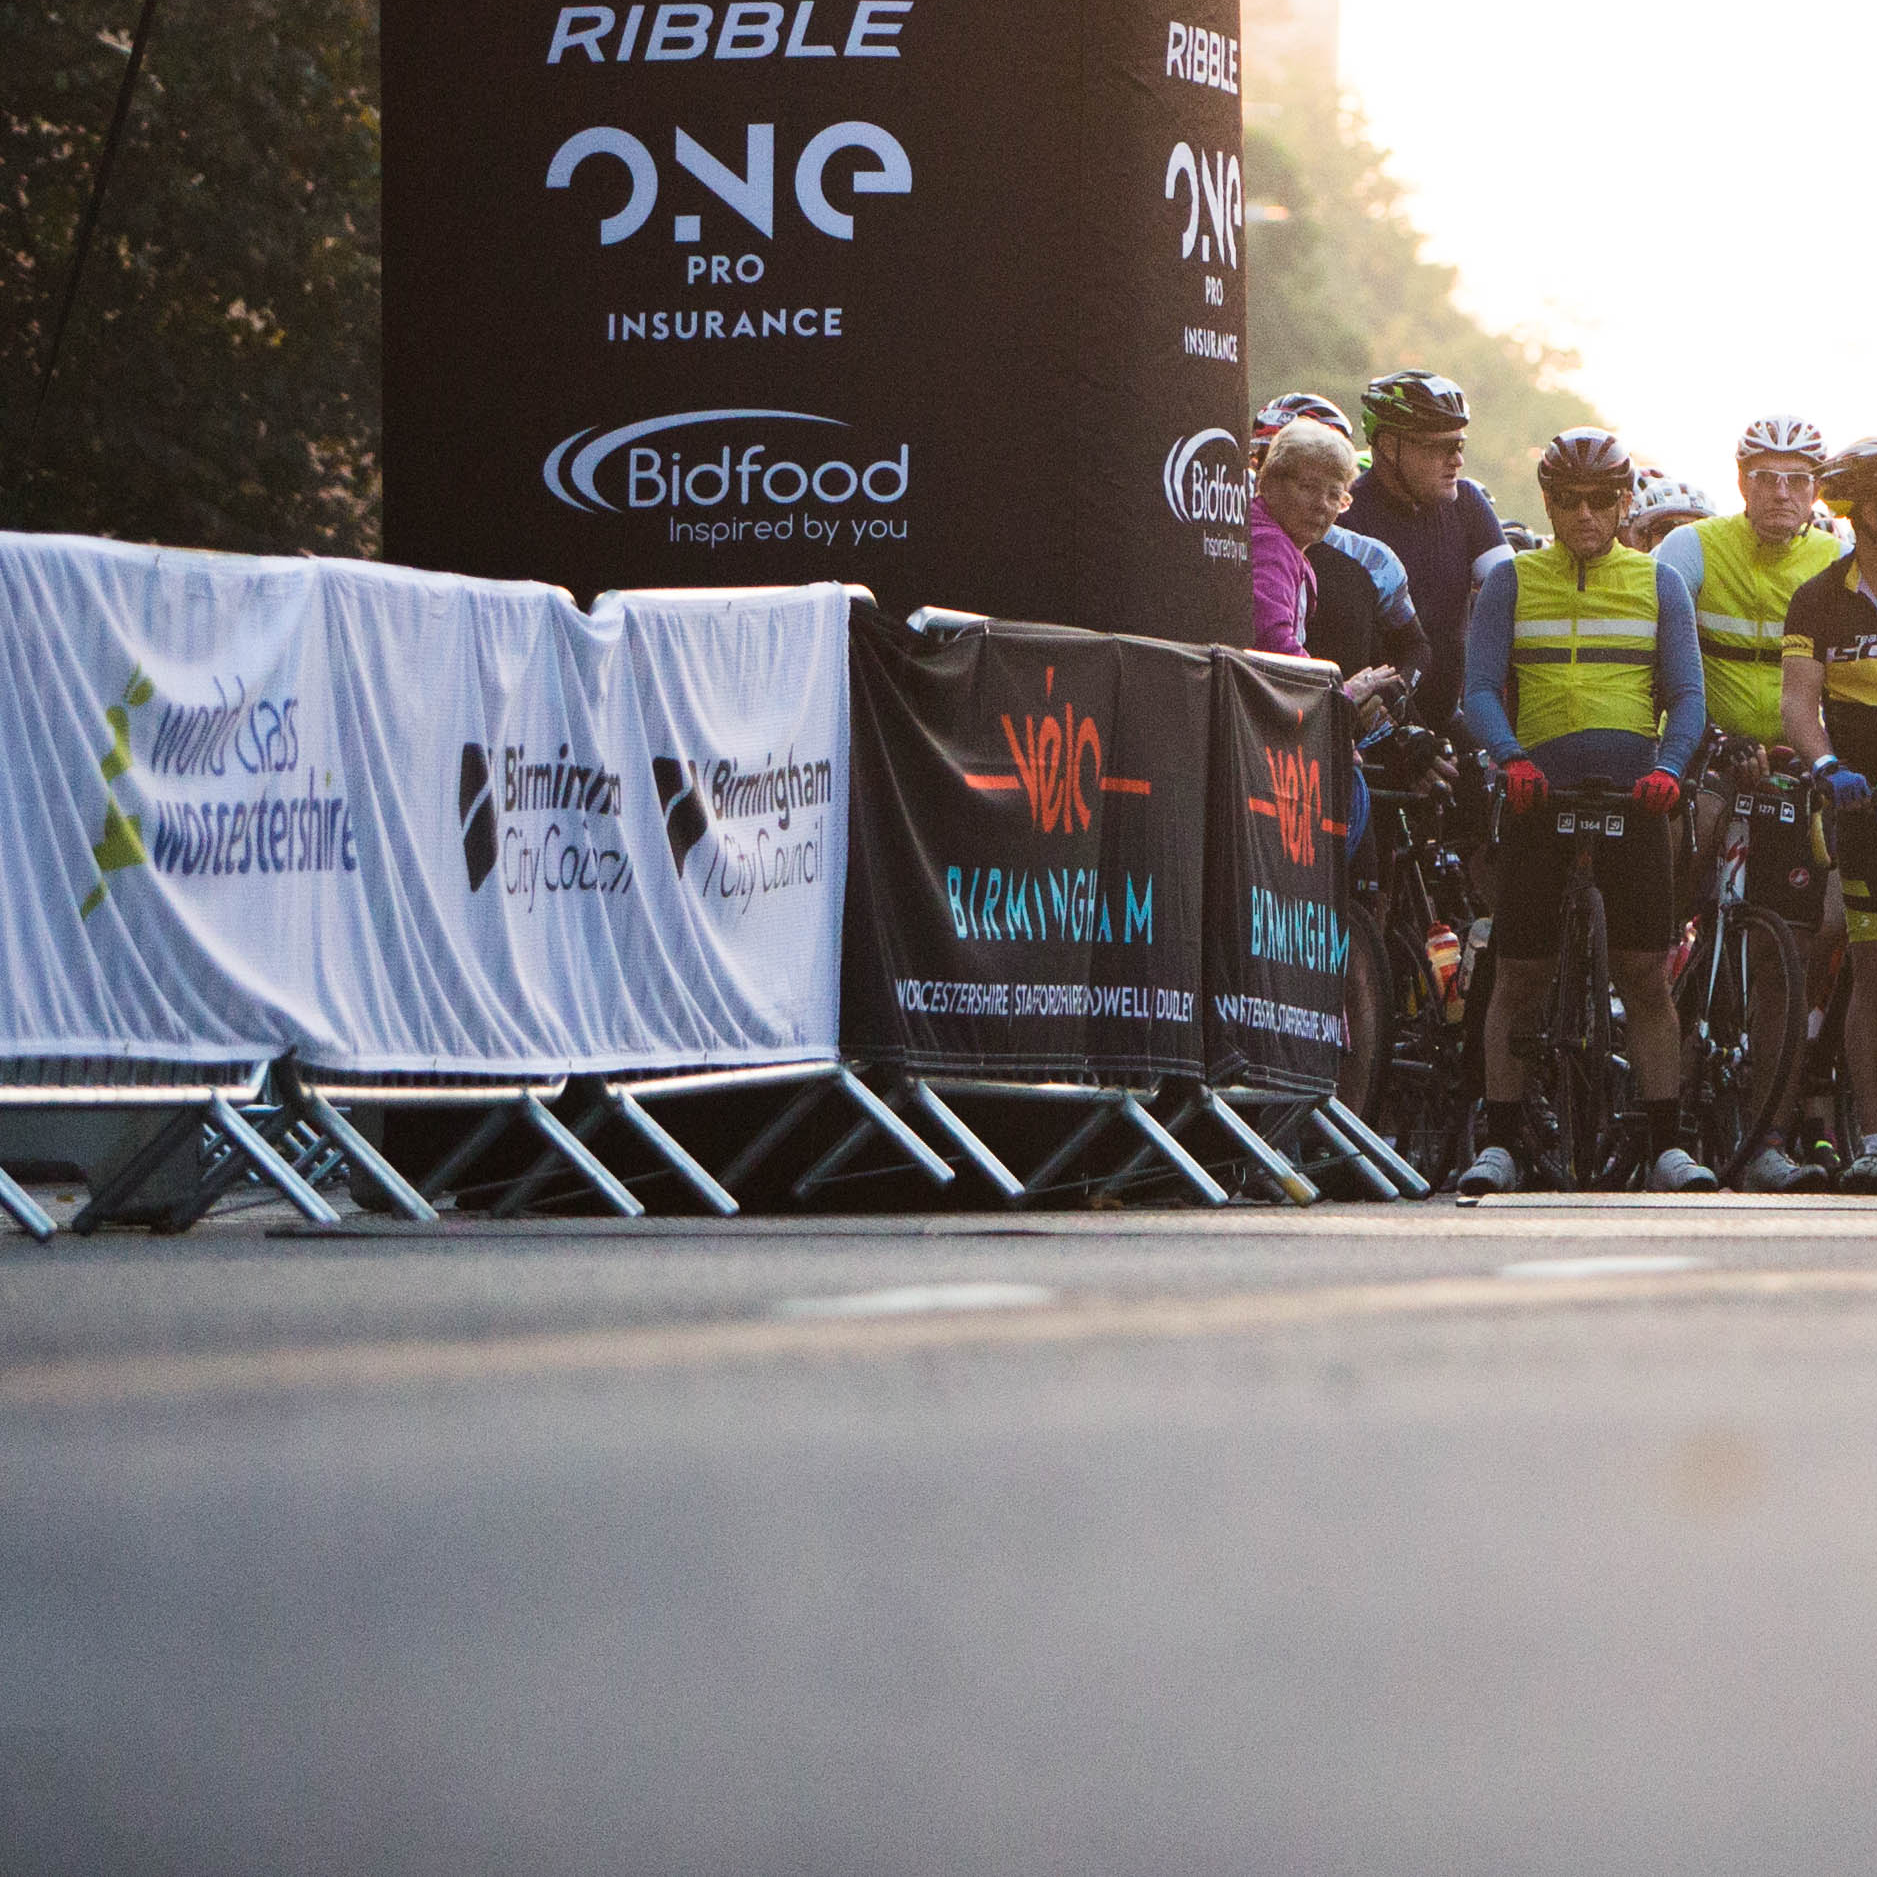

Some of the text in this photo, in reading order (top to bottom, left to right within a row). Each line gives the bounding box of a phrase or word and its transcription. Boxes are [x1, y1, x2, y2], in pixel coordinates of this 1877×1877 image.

[547, 0, 914, 64] RIBBLE
[1166, 21, 1238, 95] RIBBLE
[687, 253, 765, 284] PRO
[1205, 275, 1224, 307] PRO
[608, 308, 843, 341] INSURANCE
[1184, 326, 1238, 363] INSURANCE
[628, 443, 909, 507] Bidfood
[669, 513, 908, 548] Inspired by you
[712, 743, 832, 830] Birmingham
[503, 826, 541, 914] City
[757, 814, 824, 894] Council
[947, 865, 1153, 945] BIRMINGHAM
